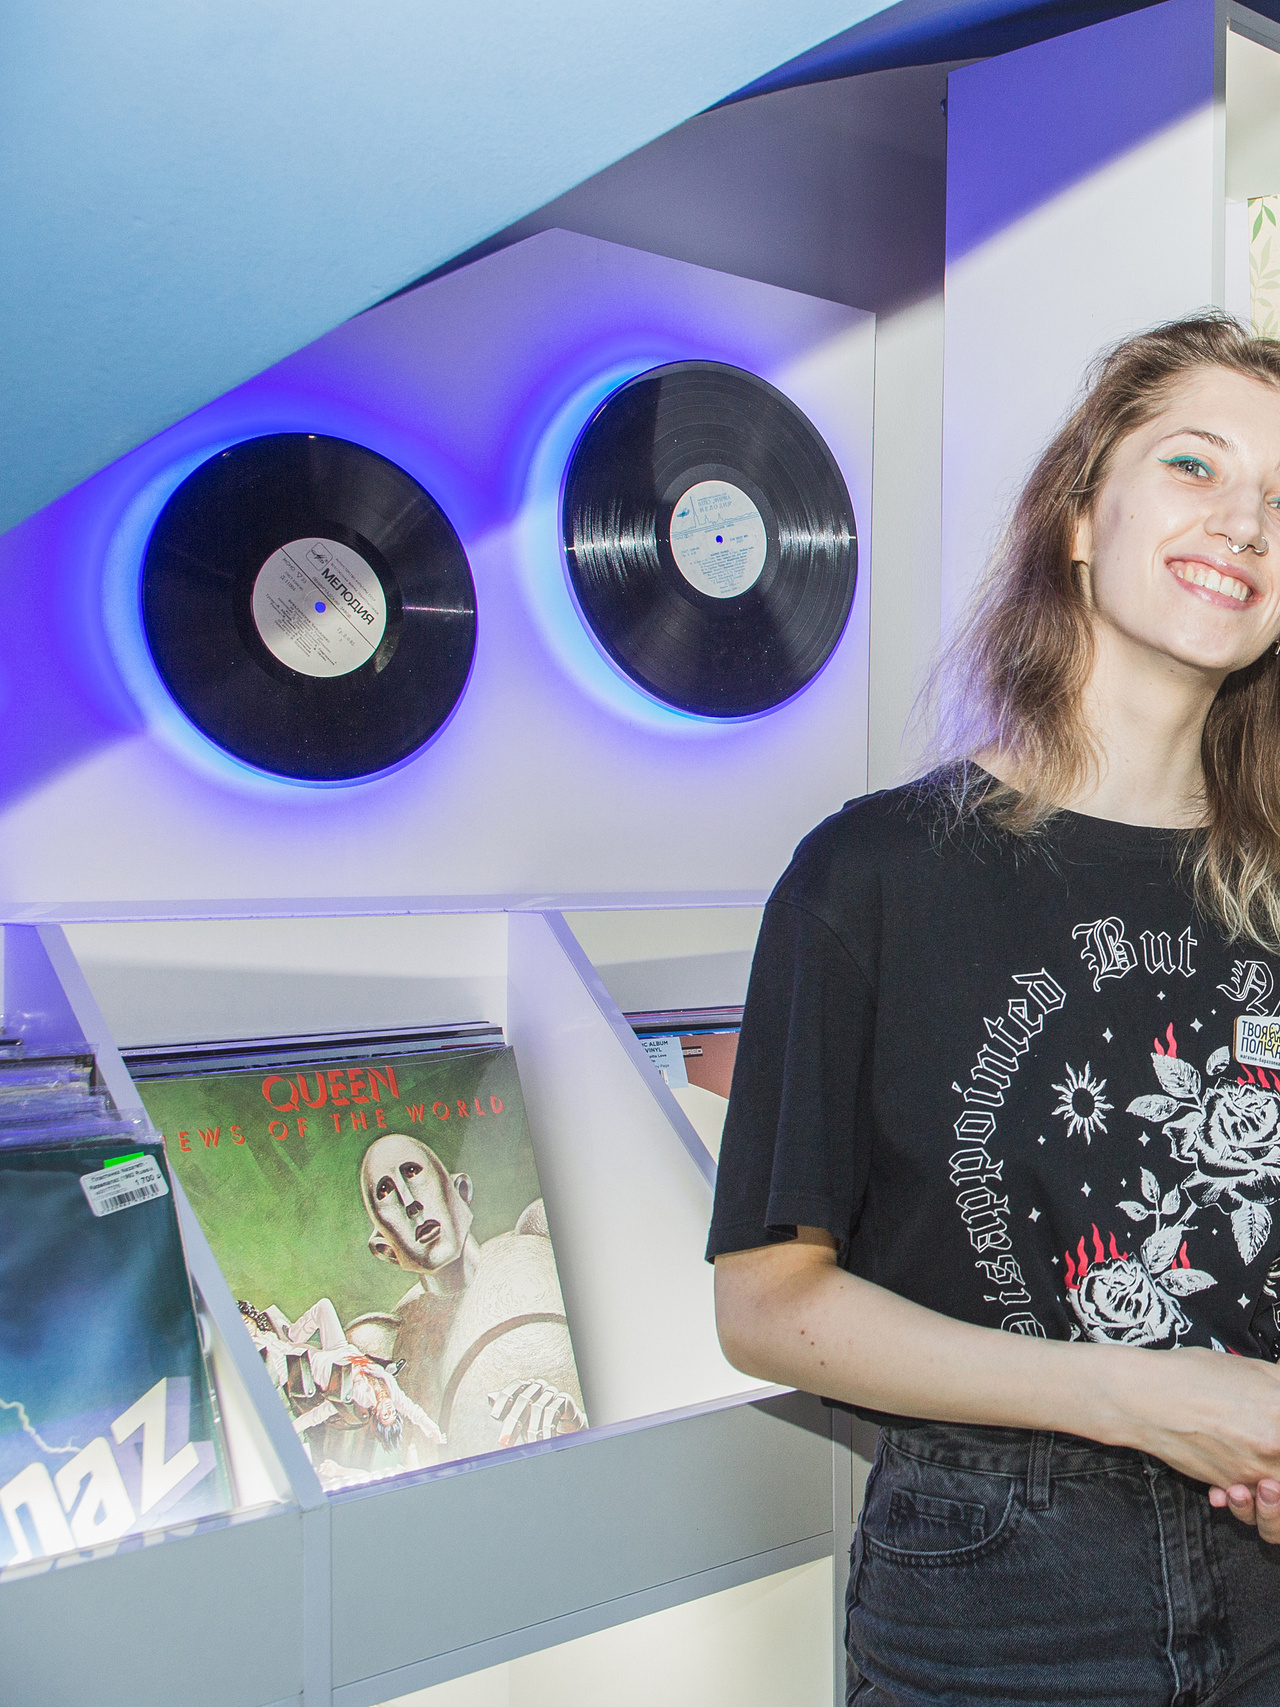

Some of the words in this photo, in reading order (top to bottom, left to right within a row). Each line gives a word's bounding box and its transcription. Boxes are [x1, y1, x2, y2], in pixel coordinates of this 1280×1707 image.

[321, 567, 375, 626] МЕЛОДИЯ
[1072, 916, 1198, 992] But
[1242, 1020, 1268, 1040] ТВОЯ
[262, 1064, 399, 1112] QUEEN
[178, 1125, 245, 1152] EWS
[268, 1117, 309, 1140] OF
[329, 1108, 387, 1133] THE
[405, 1095, 504, 1123] WORLD
[141, 1174, 155, 1184] 700
